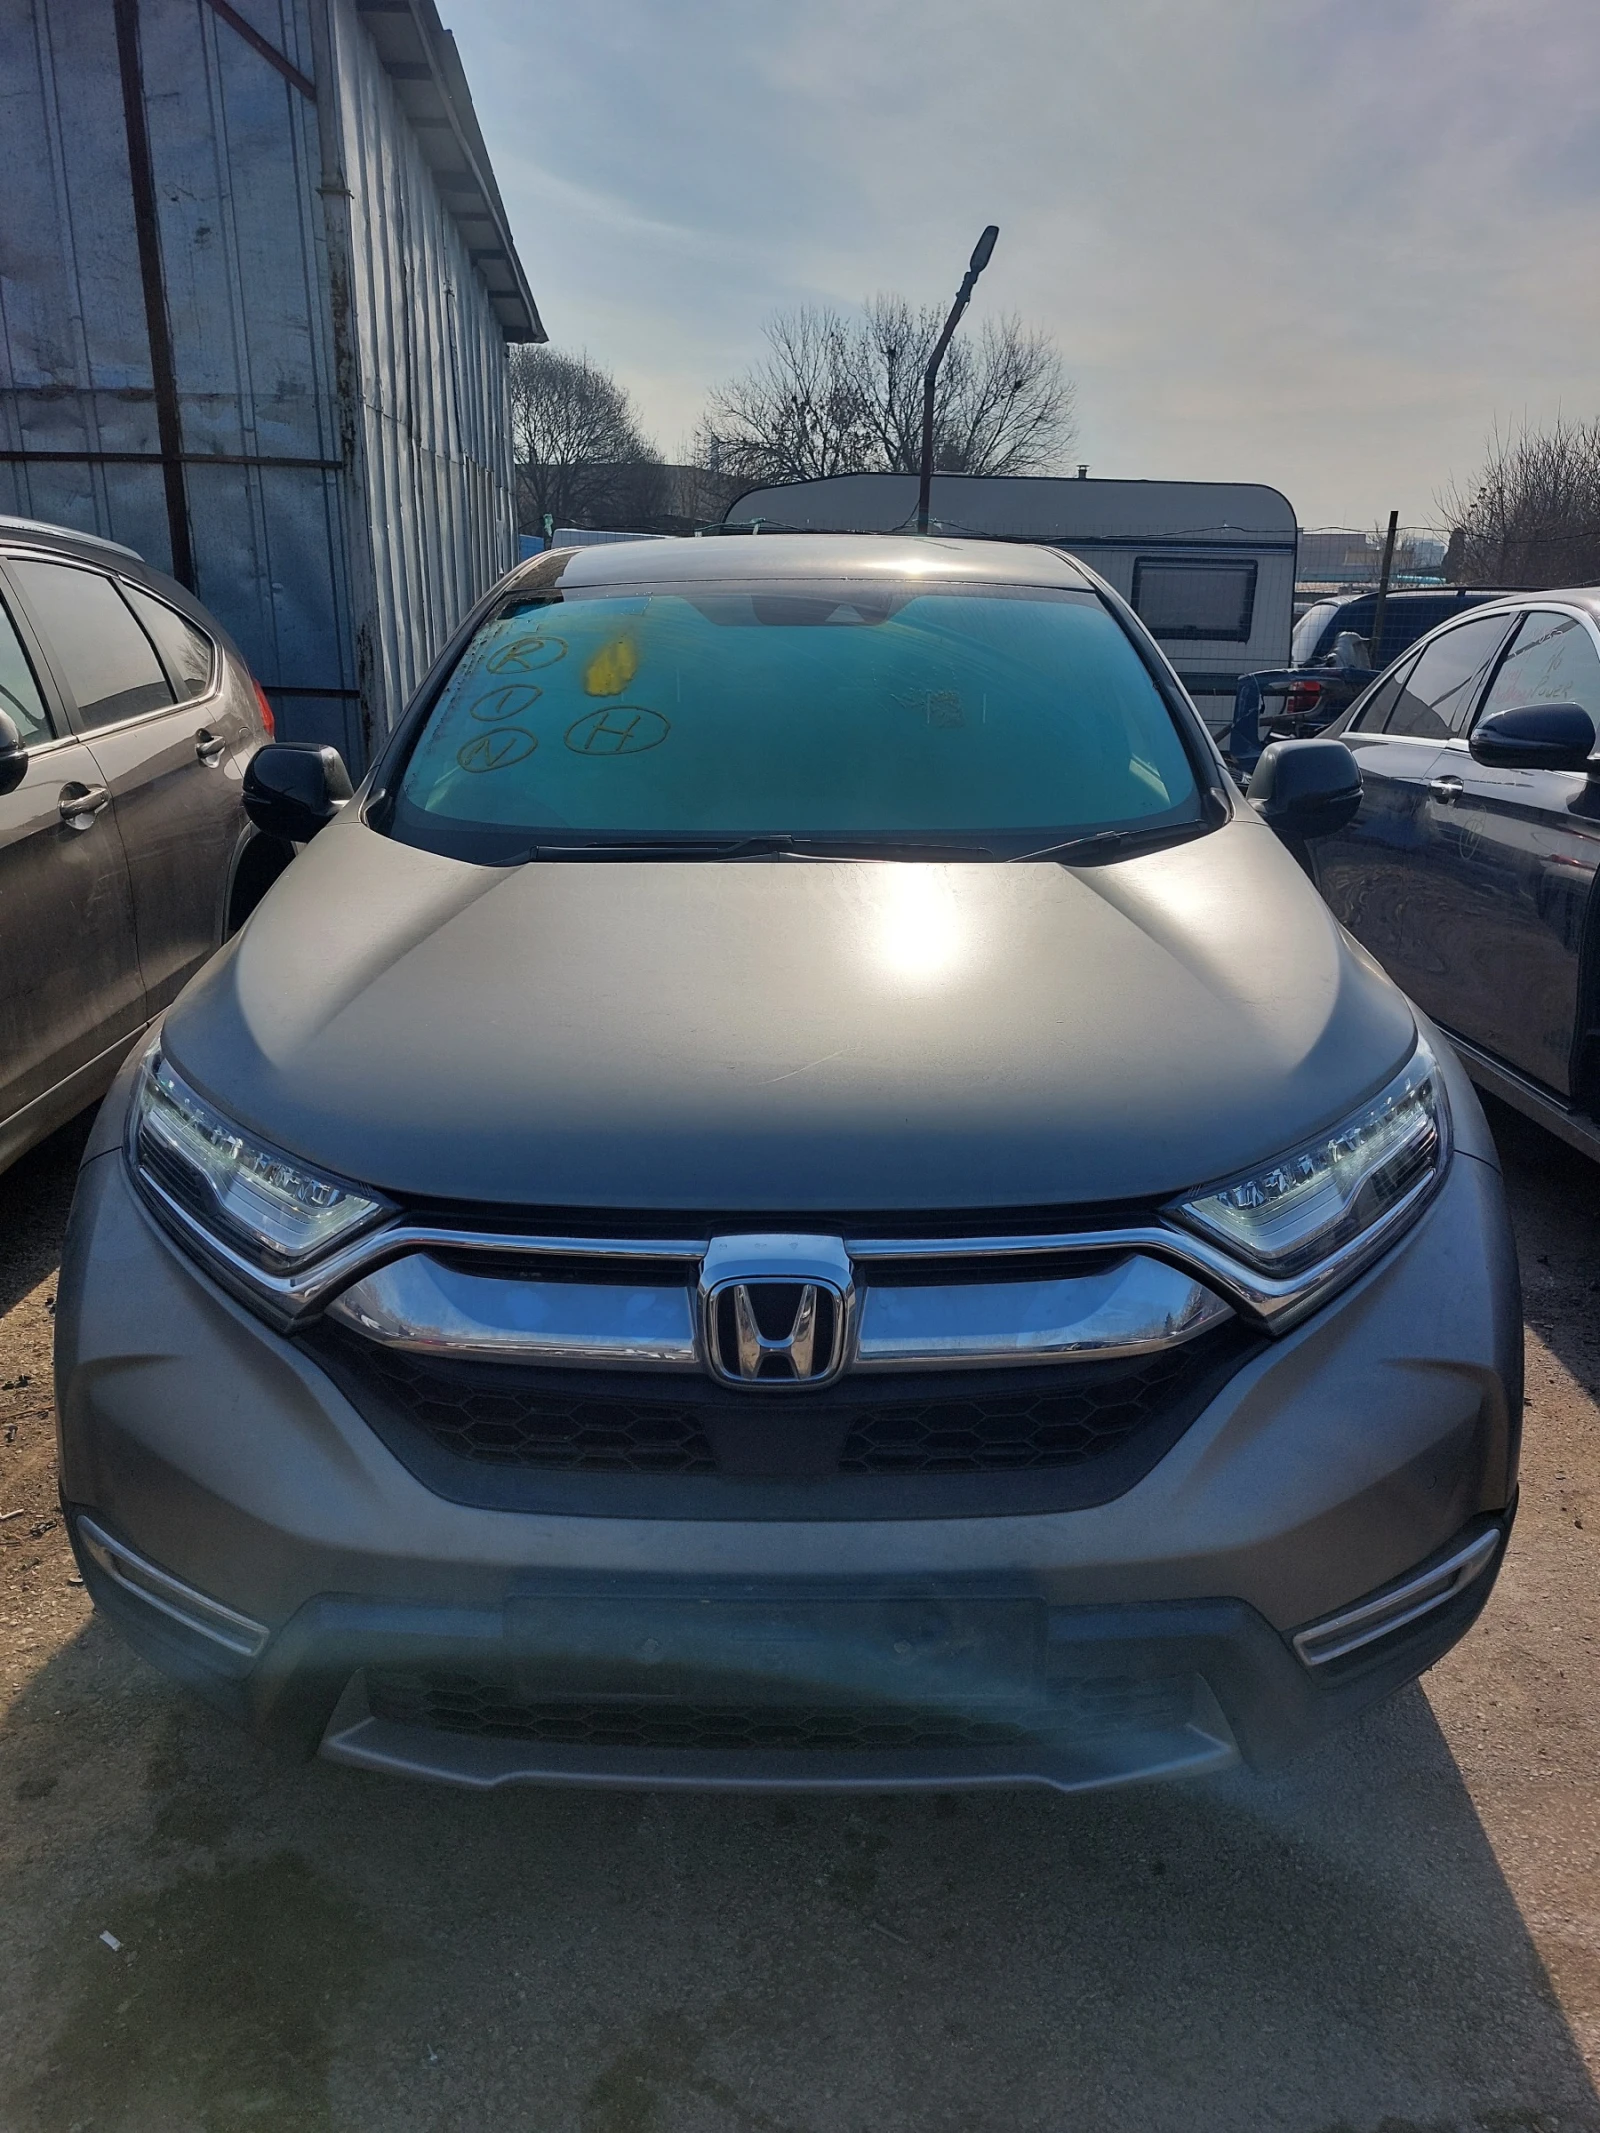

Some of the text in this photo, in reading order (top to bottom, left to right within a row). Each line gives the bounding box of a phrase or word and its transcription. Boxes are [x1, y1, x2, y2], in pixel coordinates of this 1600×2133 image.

[495, 640, 545, 671] R
[584, 712, 641, 752] H
[464, 737, 518, 767] N
